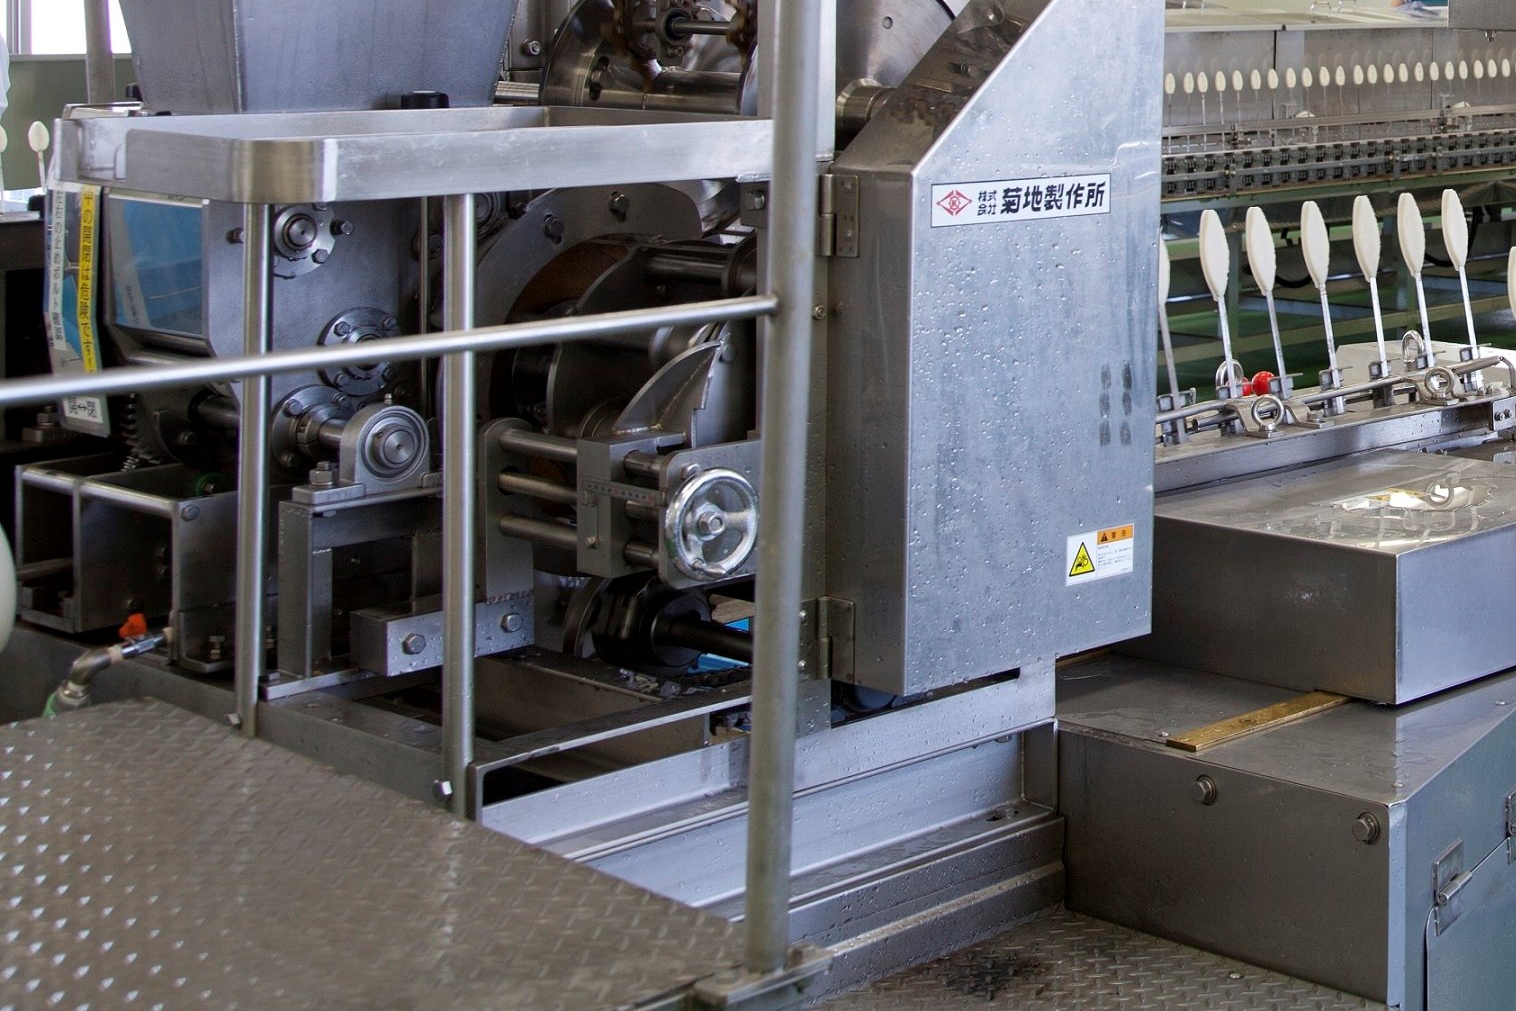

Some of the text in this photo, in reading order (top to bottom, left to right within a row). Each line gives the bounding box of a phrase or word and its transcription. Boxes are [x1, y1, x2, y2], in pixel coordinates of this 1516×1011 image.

[1000, 181, 1106, 215] 菊地製作所
